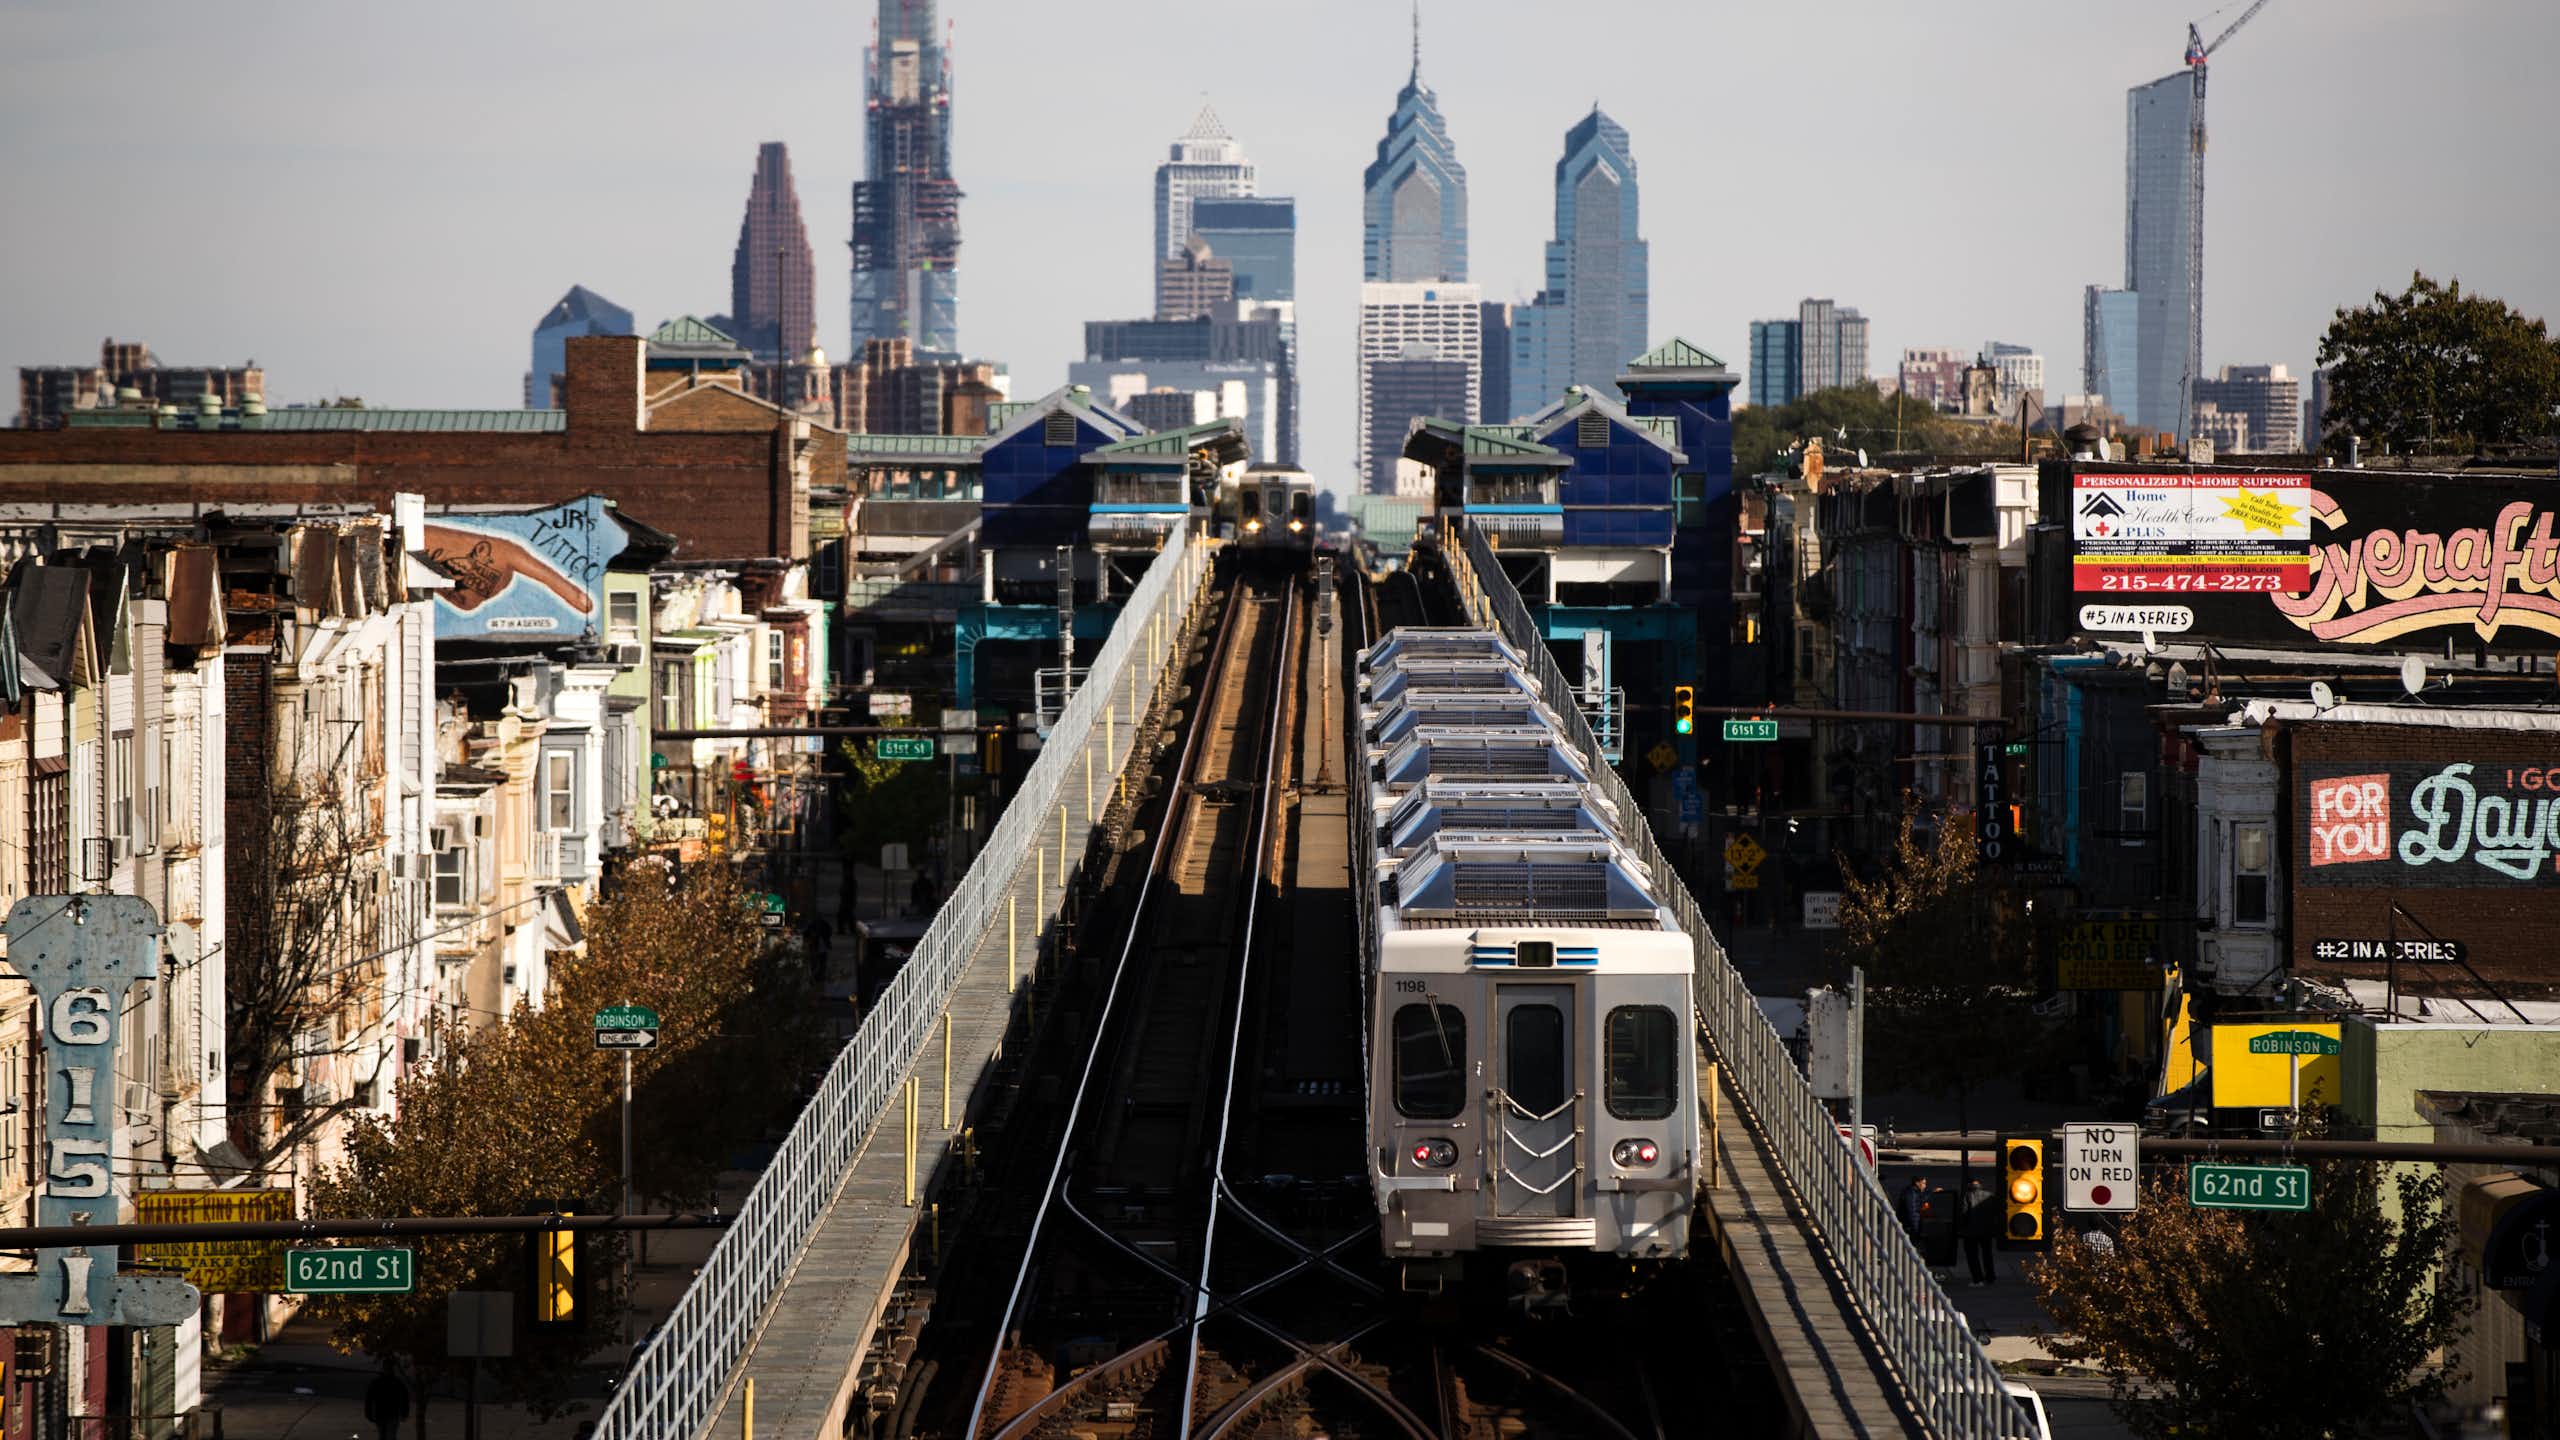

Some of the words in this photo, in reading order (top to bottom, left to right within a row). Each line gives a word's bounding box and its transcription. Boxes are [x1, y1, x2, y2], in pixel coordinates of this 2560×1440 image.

[2082, 477, 2178, 487] PERSONALIZED
[2181, 477, 2240, 487] IN-HOME
[2243, 477, 2303, 487] SUPPORT
[2126, 490, 2167, 502] Home
[2124, 506, 2179, 524] Health
[2126, 527, 2166, 537] PLUS
[529, 517, 601, 583] TATTOO
[2101, 575, 2282, 590] 215-474-2273
[2086, 610, 2106, 625] #5
[2140, 611, 2188, 625] SERIES
[1731, 724, 1753, 736] 61st
[1758, 725, 1770, 736] St
[886, 743, 910, 754] 61st
[913, 743, 925, 754] St
[1984, 744, 2001, 860] TATTOO
[2317, 782, 2385, 822] FOR
[2313, 821, 2387, 860] YOU
[2316, 941, 2350, 960] #2
[2352, 941, 2373, 959] IN
[2373, 941, 2388, 958] A
[2391, 941, 2458, 961] SERIES
[1394, 980, 1426, 993] 1198
[595, 1014, 646, 1028] ROBINSON
[2253, 1039, 2321, 1054] ROBINSON
[2327, 1044, 2338, 1054] ST
[2085, 1128, 2116, 1145] NO
[2080, 1149, 2123, 1163] TURN
[2069, 1168, 2092, 1182] ON
[2102, 1168, 2134, 1182] RED
[2202, 1173, 2264, 1198] 62nd
[2274, 1175, 2298, 1199] St
[188, 1257, 233, 1268] TAKE
[299, 1254, 363, 1281] 62nd
[375, 1255, 400, 1280] St
